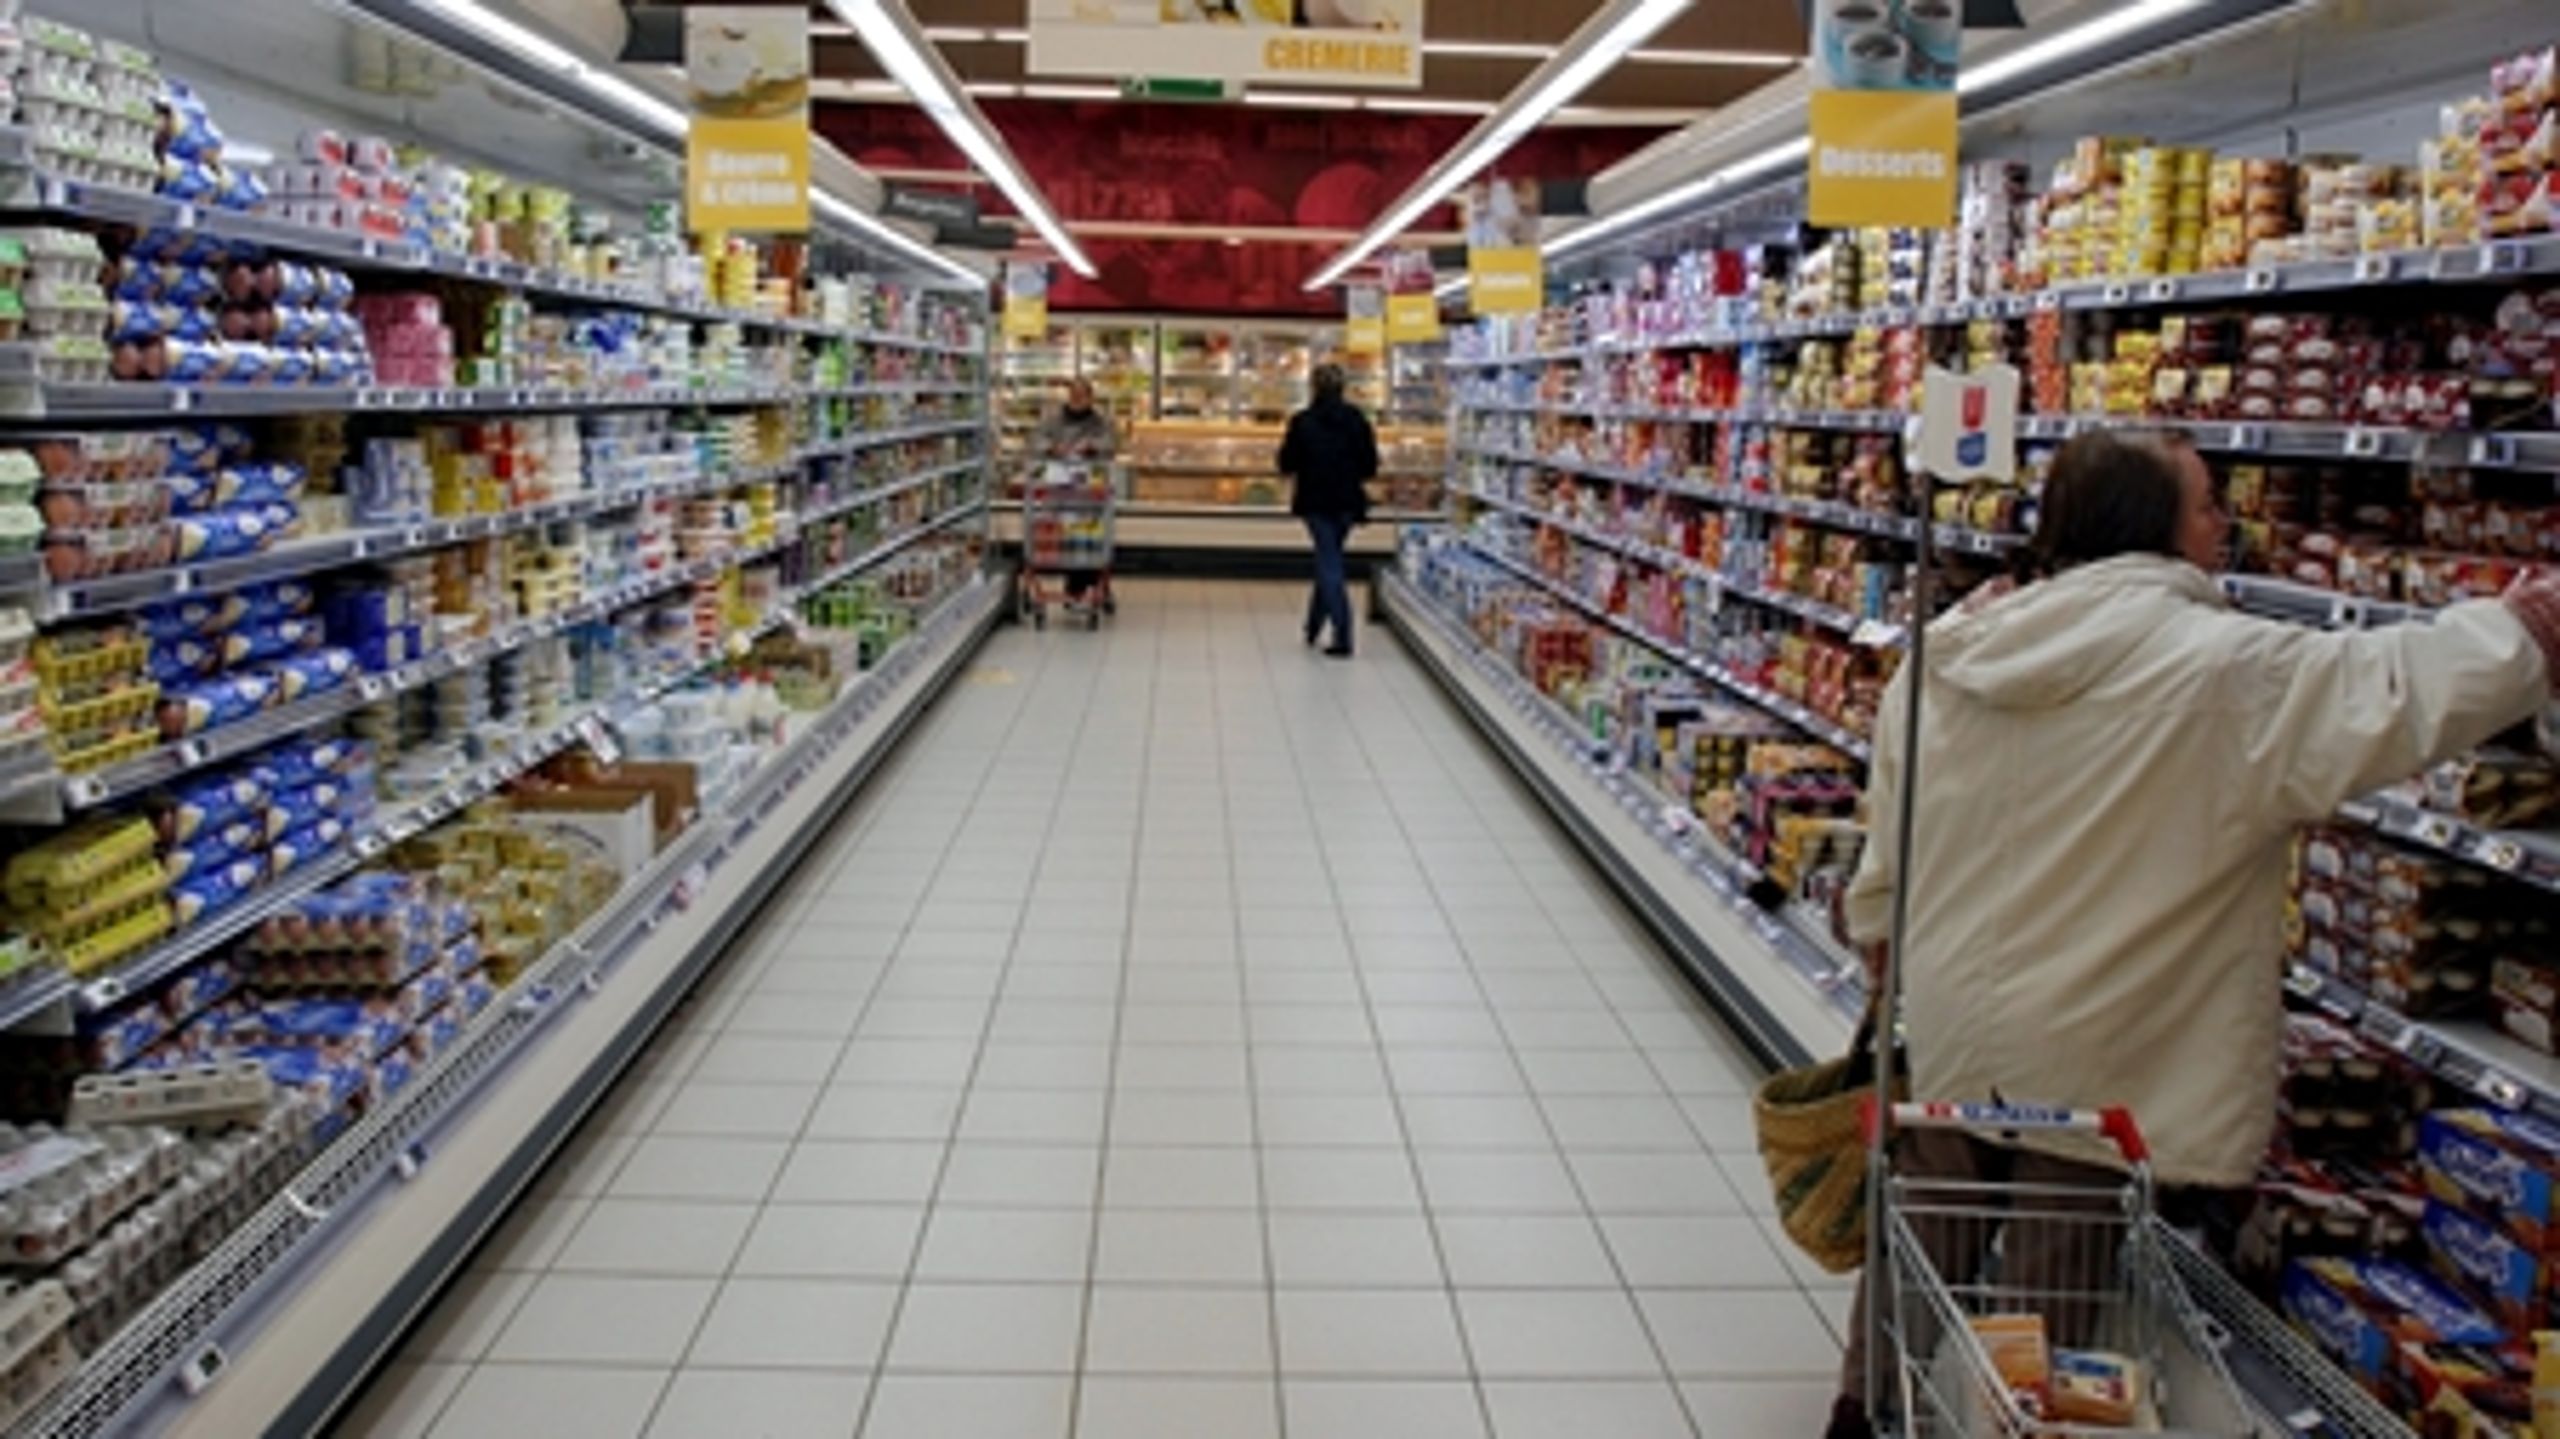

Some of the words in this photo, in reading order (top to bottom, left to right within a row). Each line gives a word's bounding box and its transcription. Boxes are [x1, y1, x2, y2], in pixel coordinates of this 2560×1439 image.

[1264, 37, 1412, 76] CREMERIE
[706, 150, 790, 176] Beurre
[1821, 146, 1945, 178] Desserts
